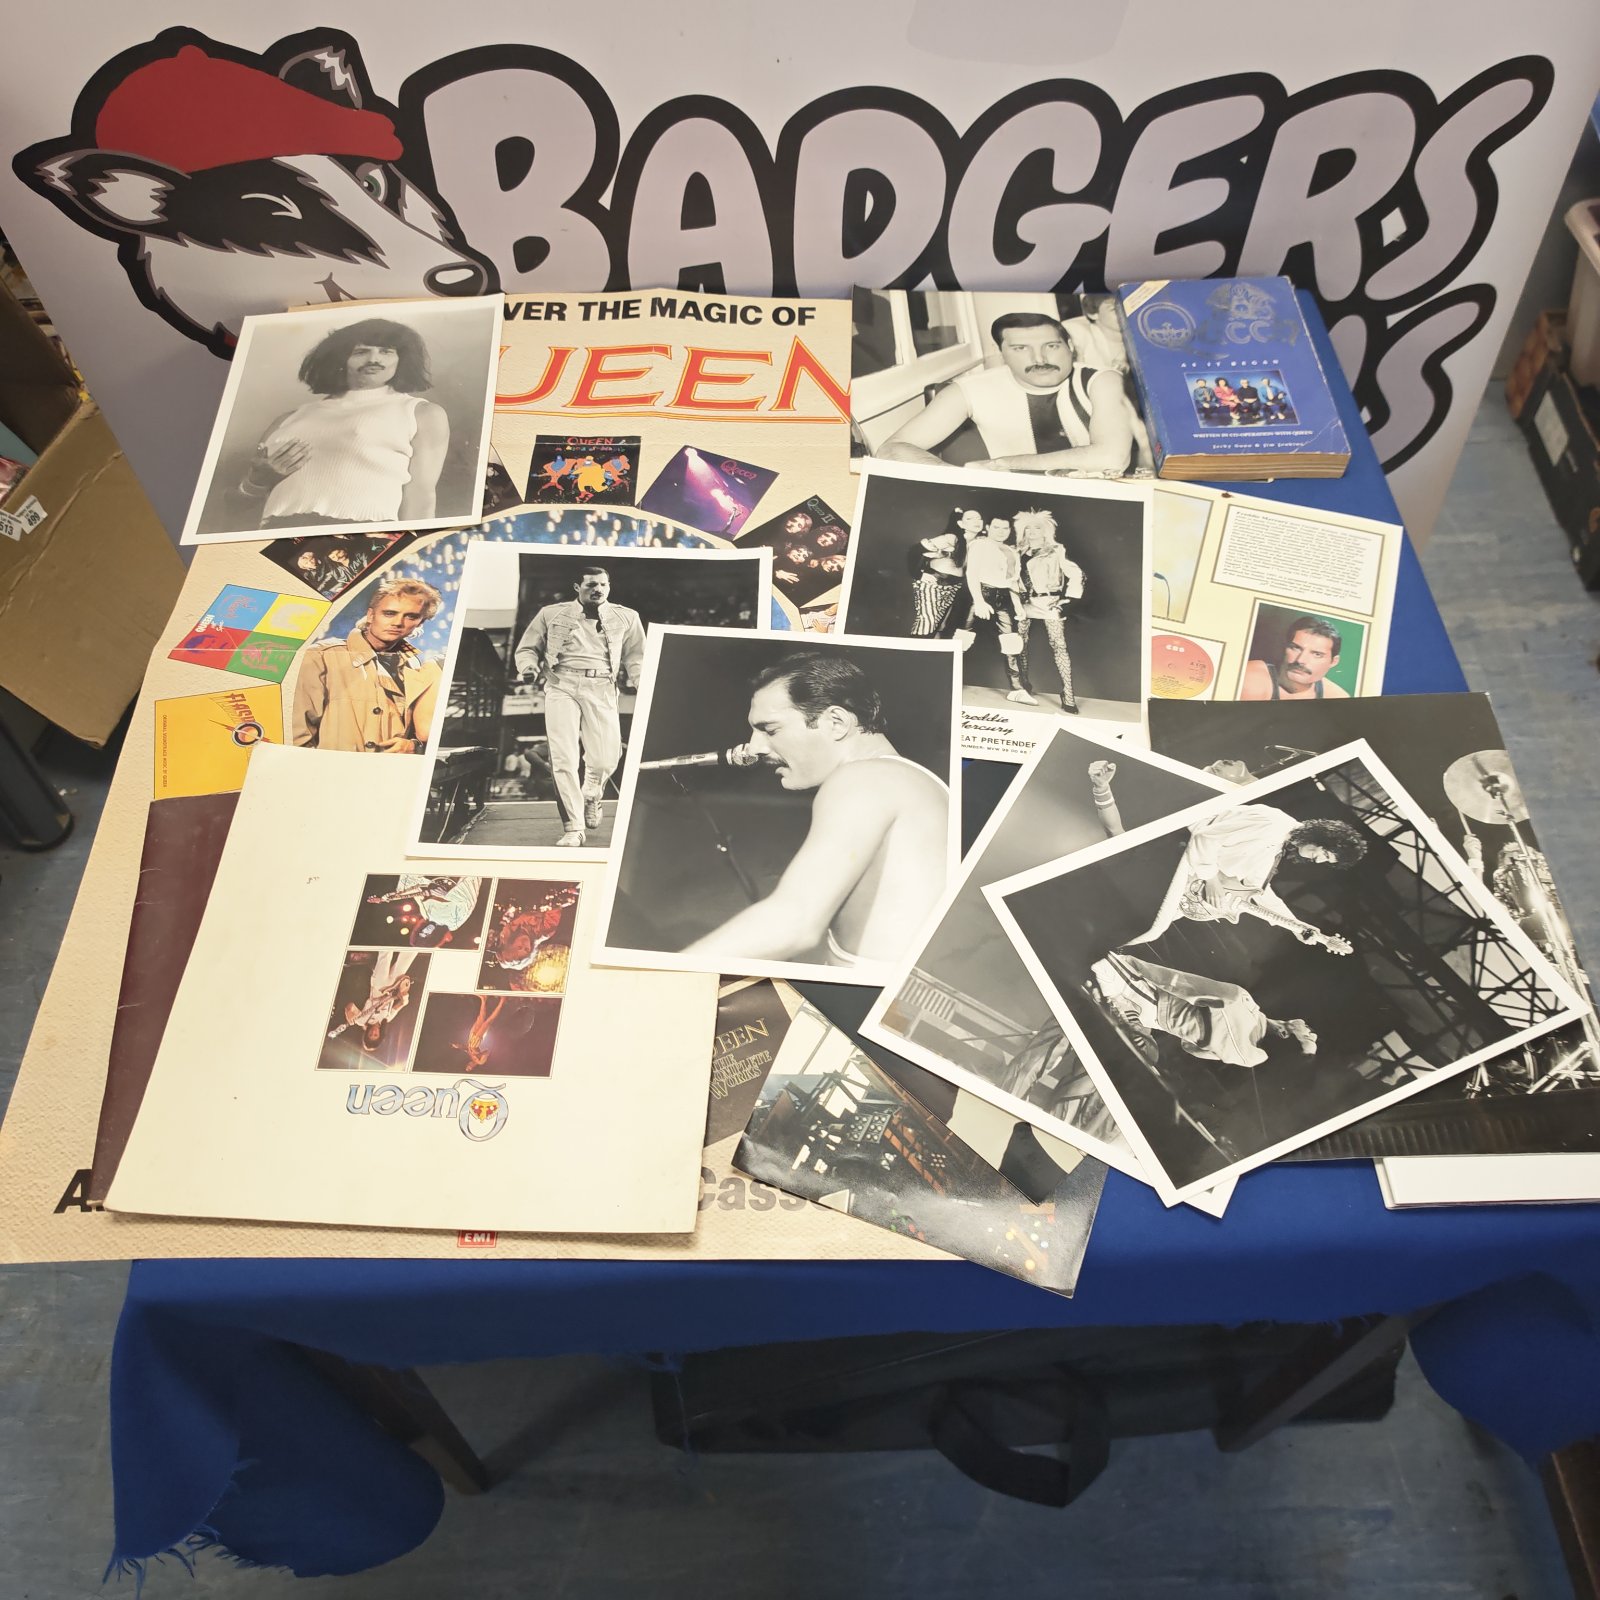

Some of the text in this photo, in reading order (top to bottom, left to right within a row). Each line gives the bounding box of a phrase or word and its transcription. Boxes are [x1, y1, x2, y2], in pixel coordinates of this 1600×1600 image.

[402, 45, 1554, 304] BADGERS
[578, 299, 642, 321] THE
[650, 297, 762, 326] MAGIC
[772, 307, 816, 326] OF
[27, 511, 40, 527] 499
[1165, 643, 1185, 654] CBS
[961, 721, 1014, 736] ercury
[346, 1078, 509, 1142] Queen
[464, 1232, 491, 1243] EMI
